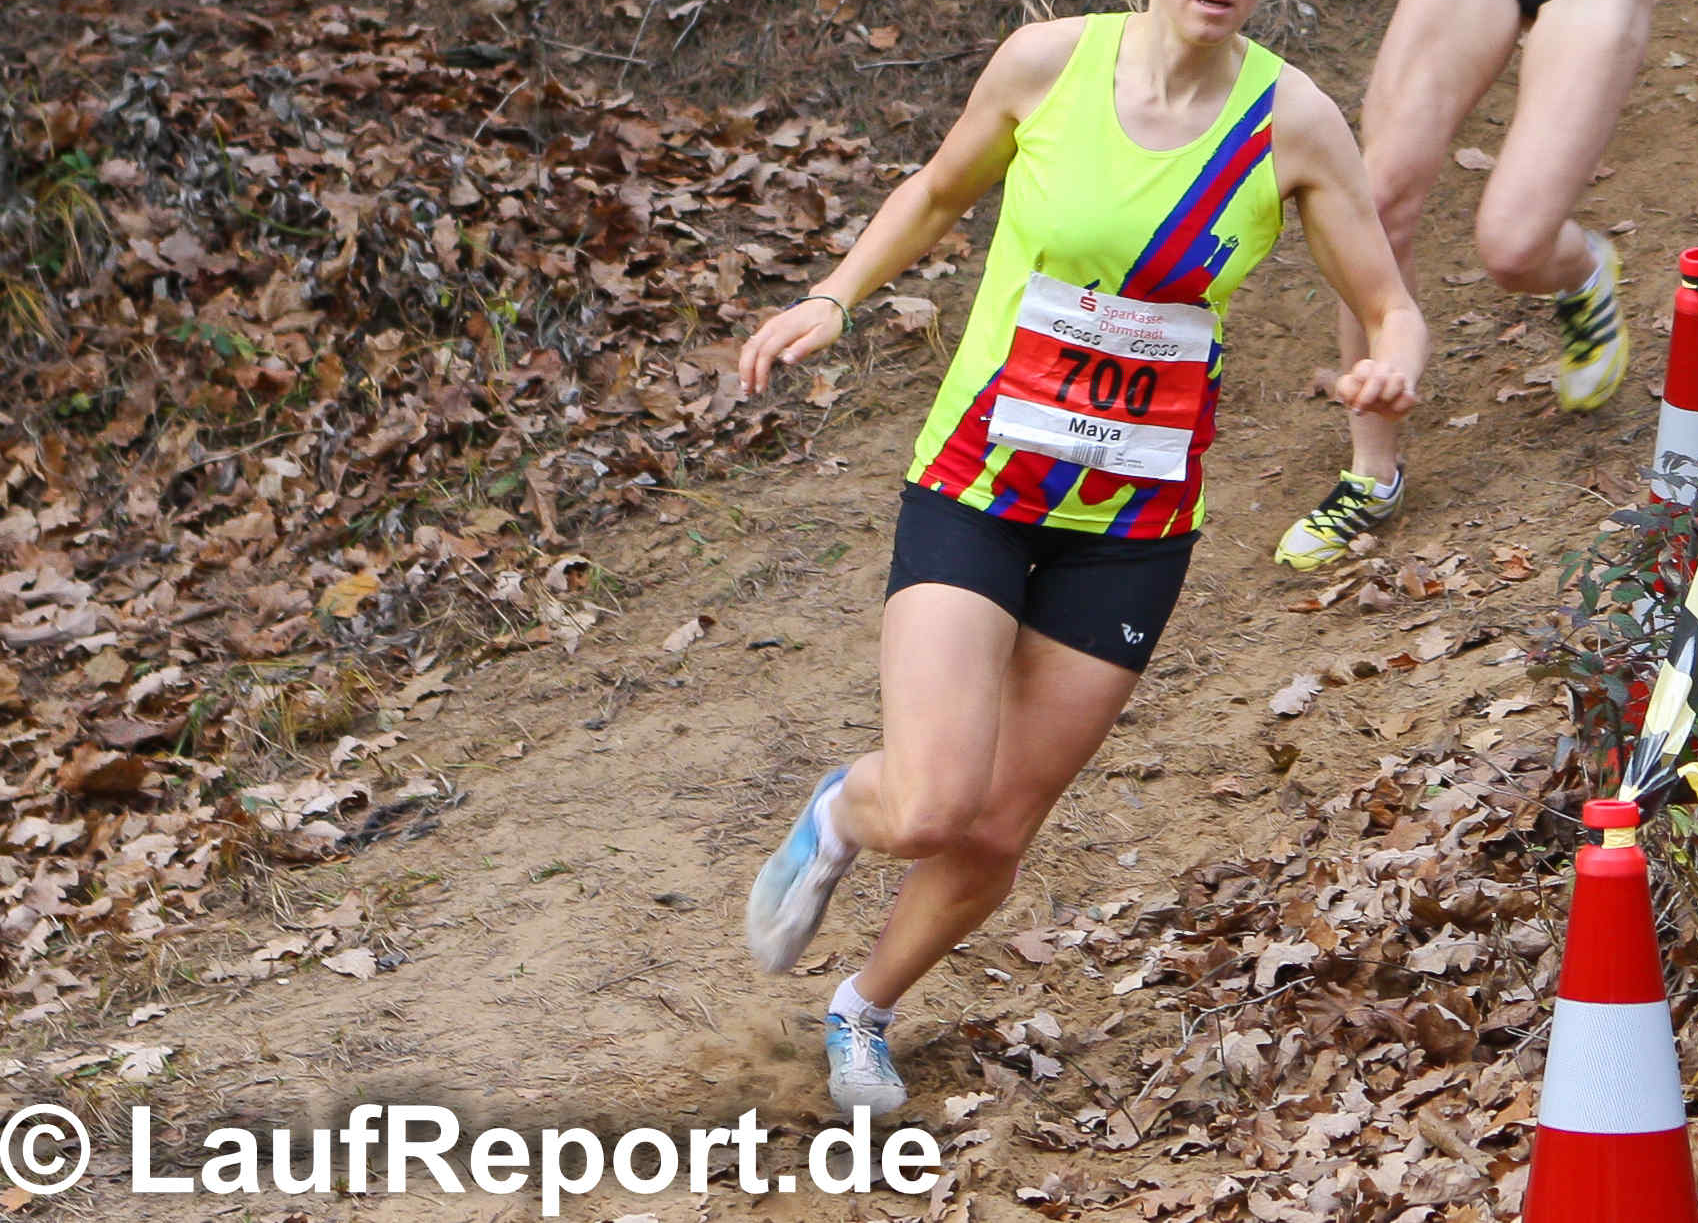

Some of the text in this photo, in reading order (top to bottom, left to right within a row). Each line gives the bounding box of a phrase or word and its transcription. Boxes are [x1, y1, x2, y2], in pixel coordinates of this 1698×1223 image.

[1103, 305, 1165, 324] Sparkasse
[1052, 319, 1179, 357] Cross Cross
[1099, 320, 1165, 340] Darmstadt
[1055, 348, 1159, 417] 700
[1068, 417, 1122, 442] Maya
